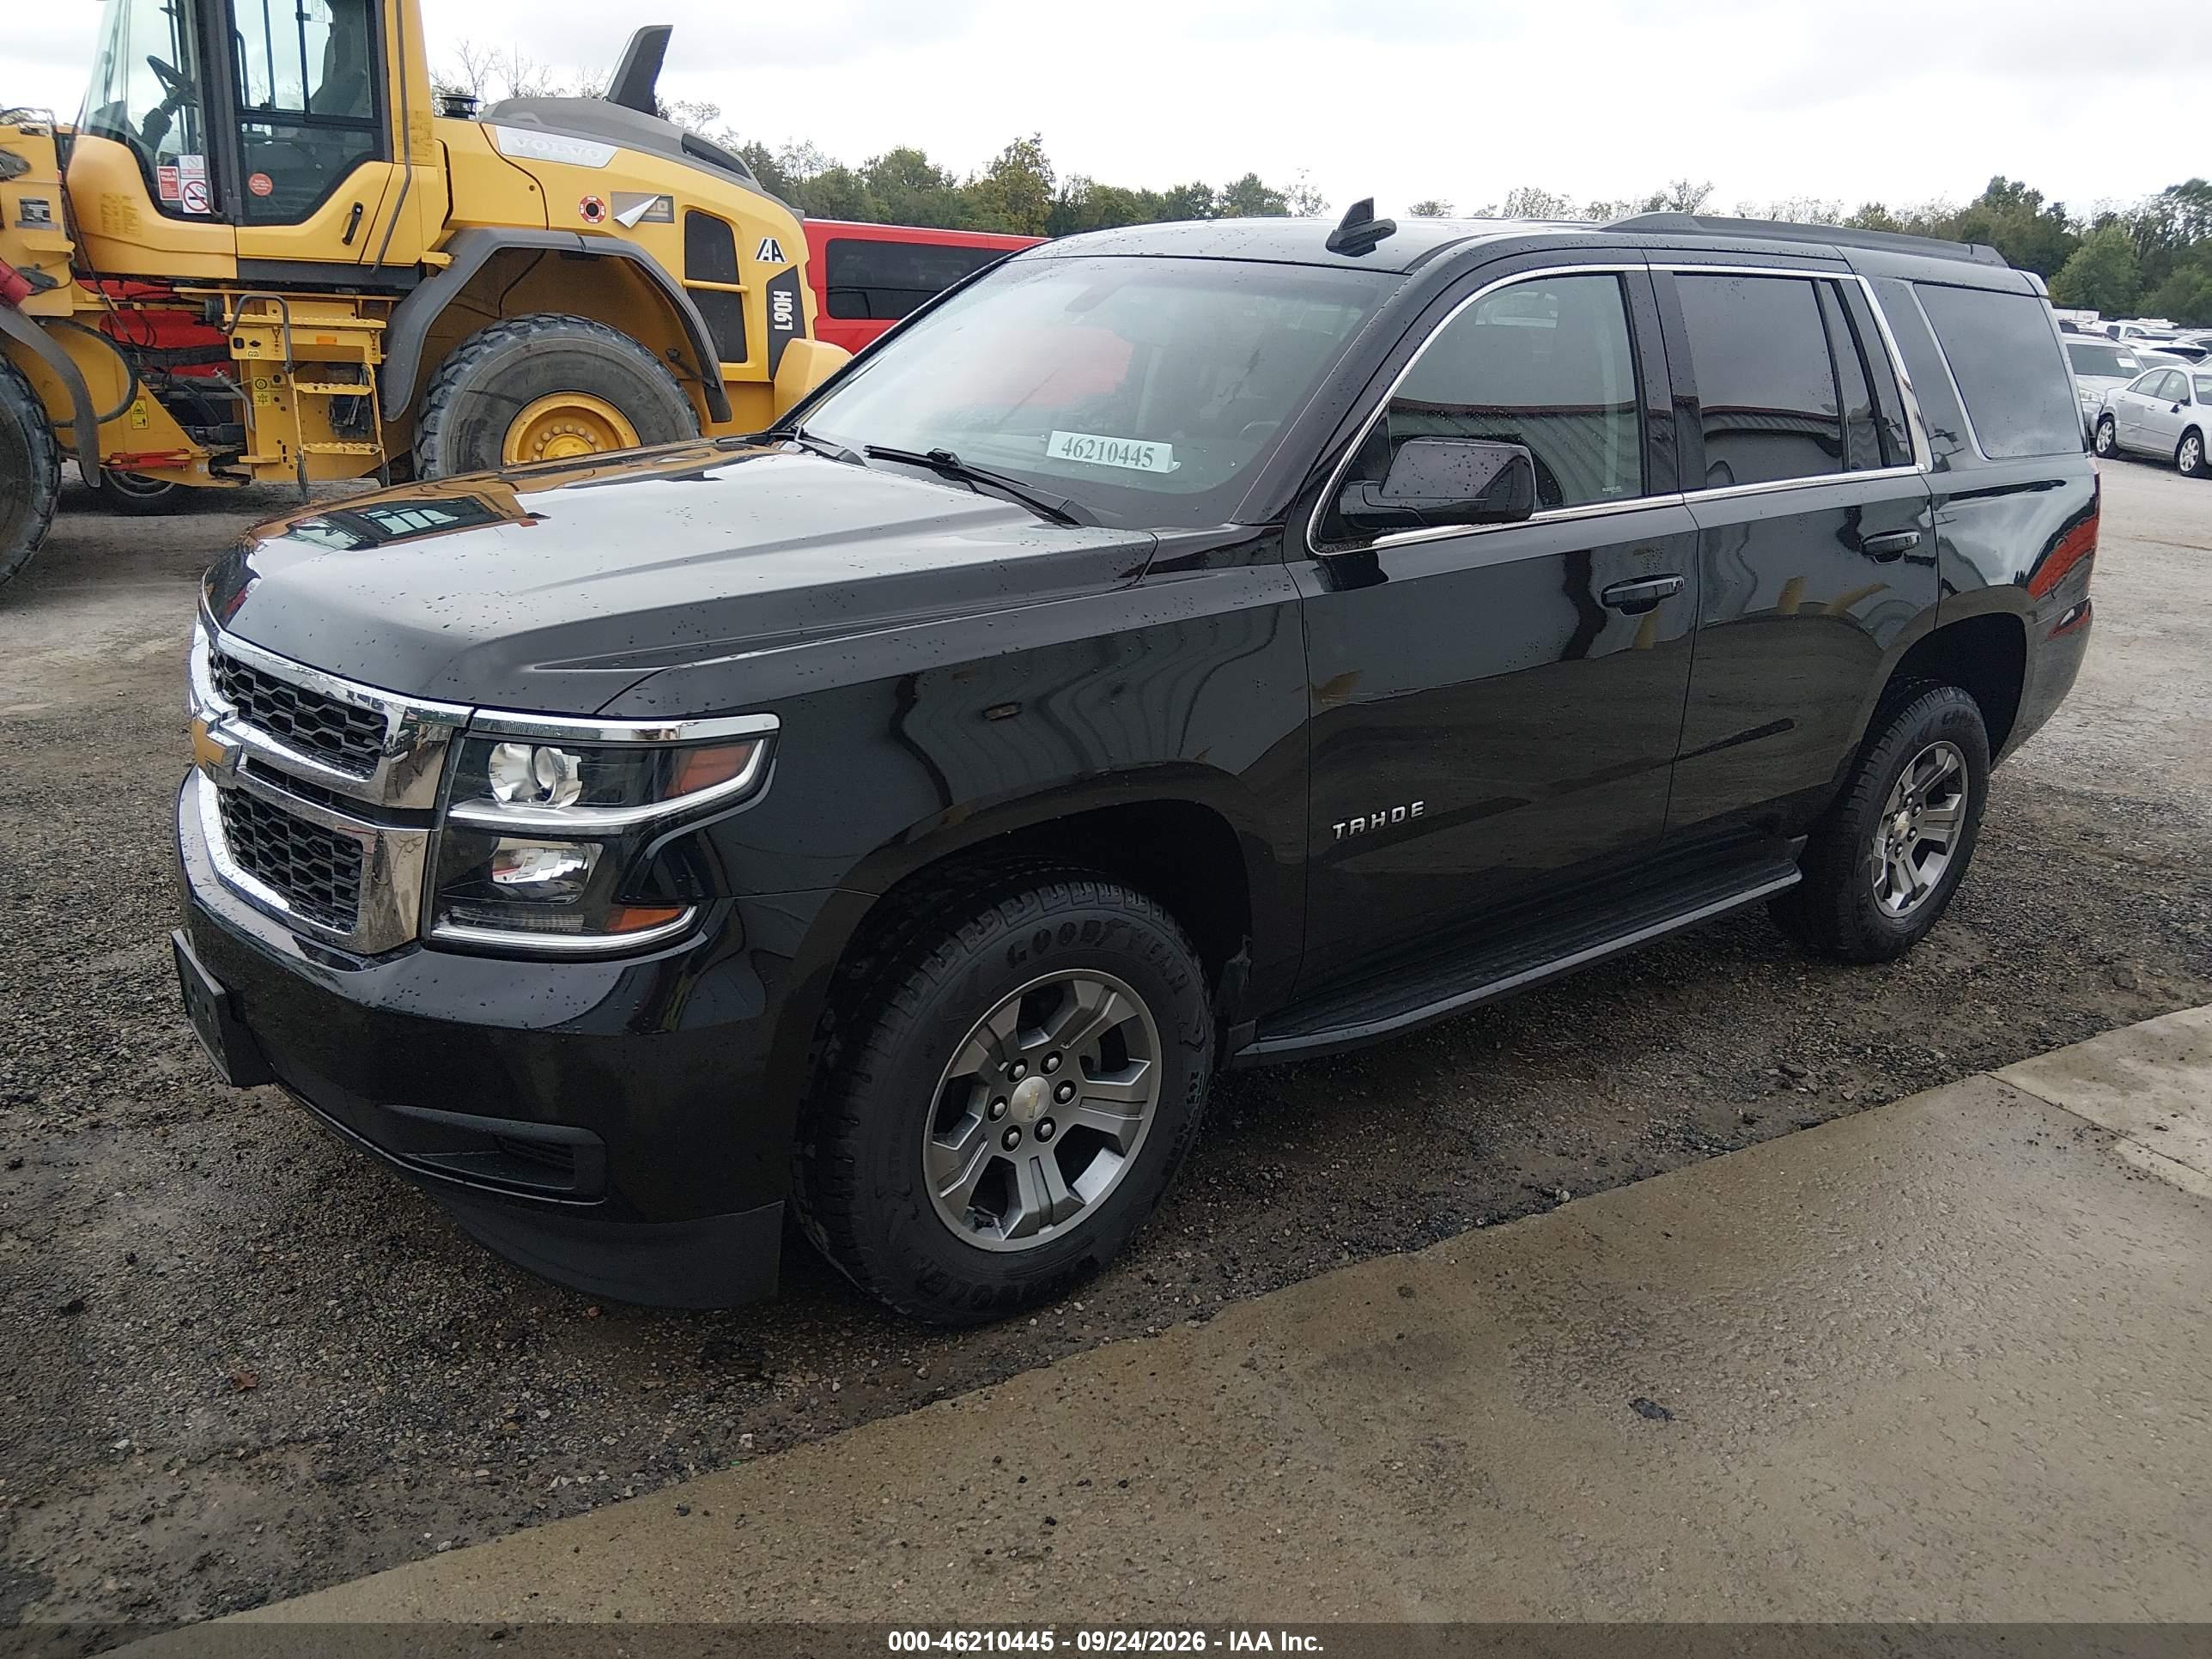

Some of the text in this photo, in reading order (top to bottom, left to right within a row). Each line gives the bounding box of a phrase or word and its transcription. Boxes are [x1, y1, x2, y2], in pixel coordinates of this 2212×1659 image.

[514, 137, 604, 159] VOLVO
[773, 290, 793, 331] L90H
[1060, 436, 1155, 468] 46210445
[1333, 800, 1425, 840] TAHOE
[1006, 918, 1190, 995] GOODYEAR
